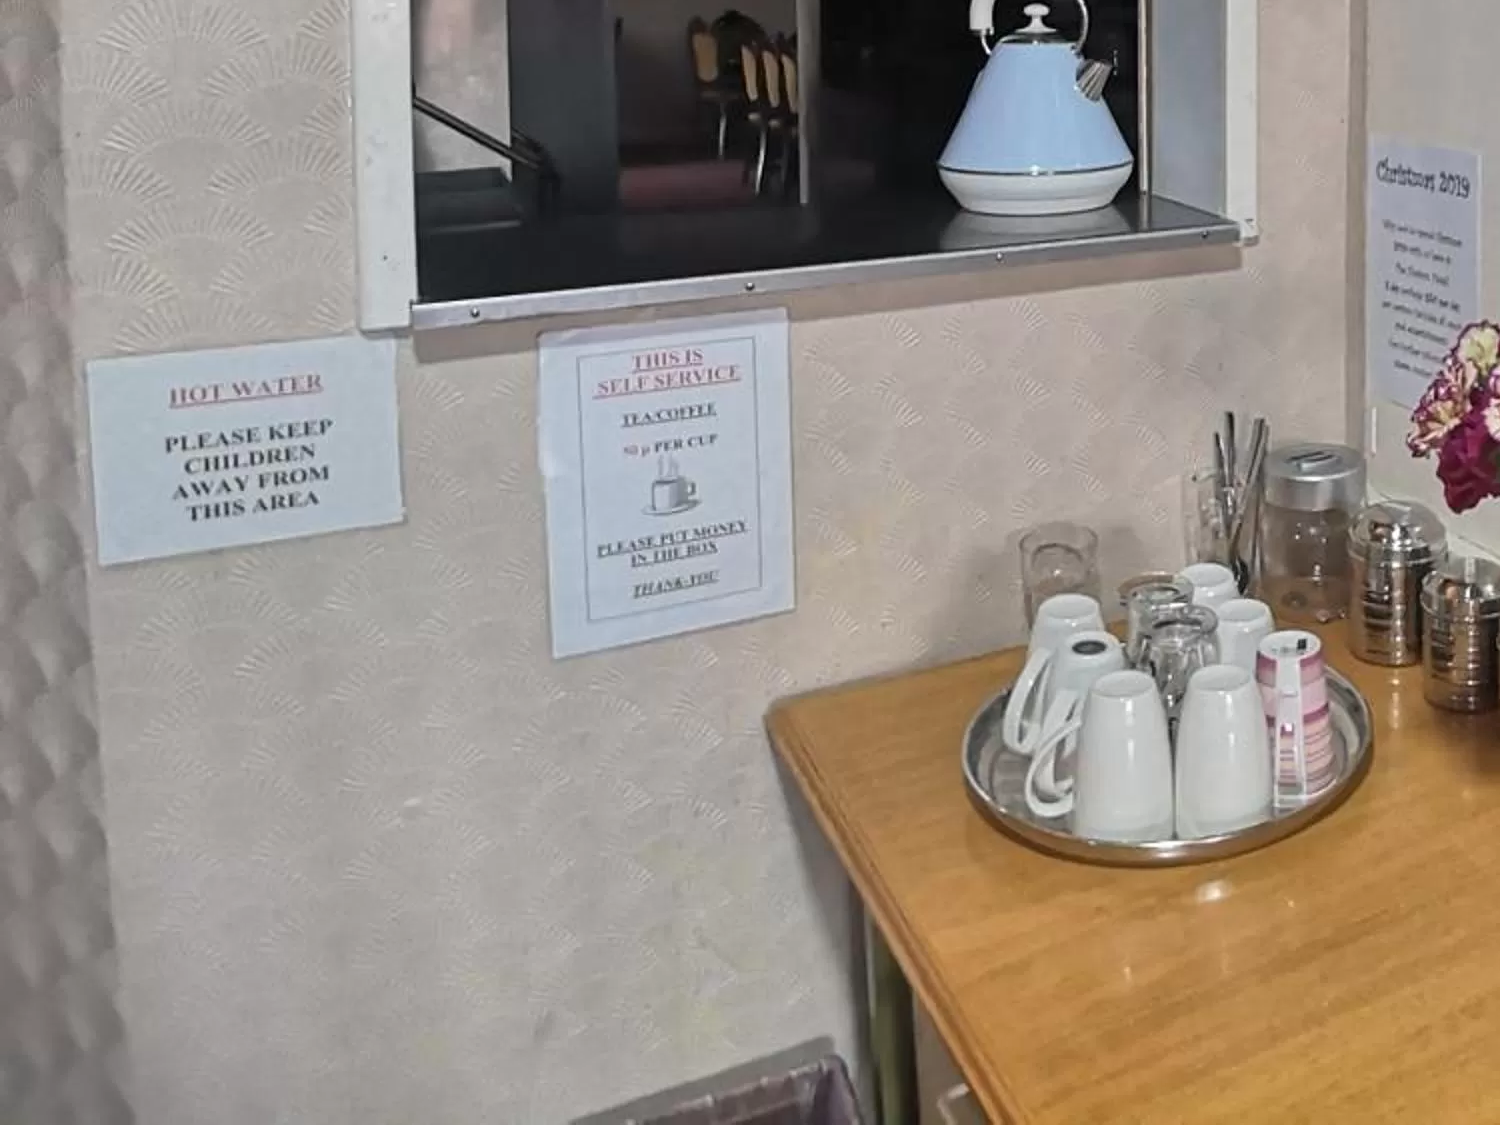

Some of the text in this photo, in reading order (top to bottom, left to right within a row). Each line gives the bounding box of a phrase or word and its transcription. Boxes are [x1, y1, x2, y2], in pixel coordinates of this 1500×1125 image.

[1375, 155, 1471, 200] Christmas 2019
[632, 347, 705, 371] THIS IS
[169, 373, 324, 406] HOT WATER
[597, 363, 742, 397] SELF SERVICE
[164, 418, 335, 454] PLEASE KEEP
[654, 437, 683, 453] PER
[687, 433, 719, 448] CUP
[183, 442, 317, 476] CHILDREN
[171, 464, 331, 502] AWAY FROM
[185, 490, 321, 522] THIS AREA
[596, 520, 749, 559] PLEASE PUT MONEY
[630, 540, 719, 568] IN THE BOX
